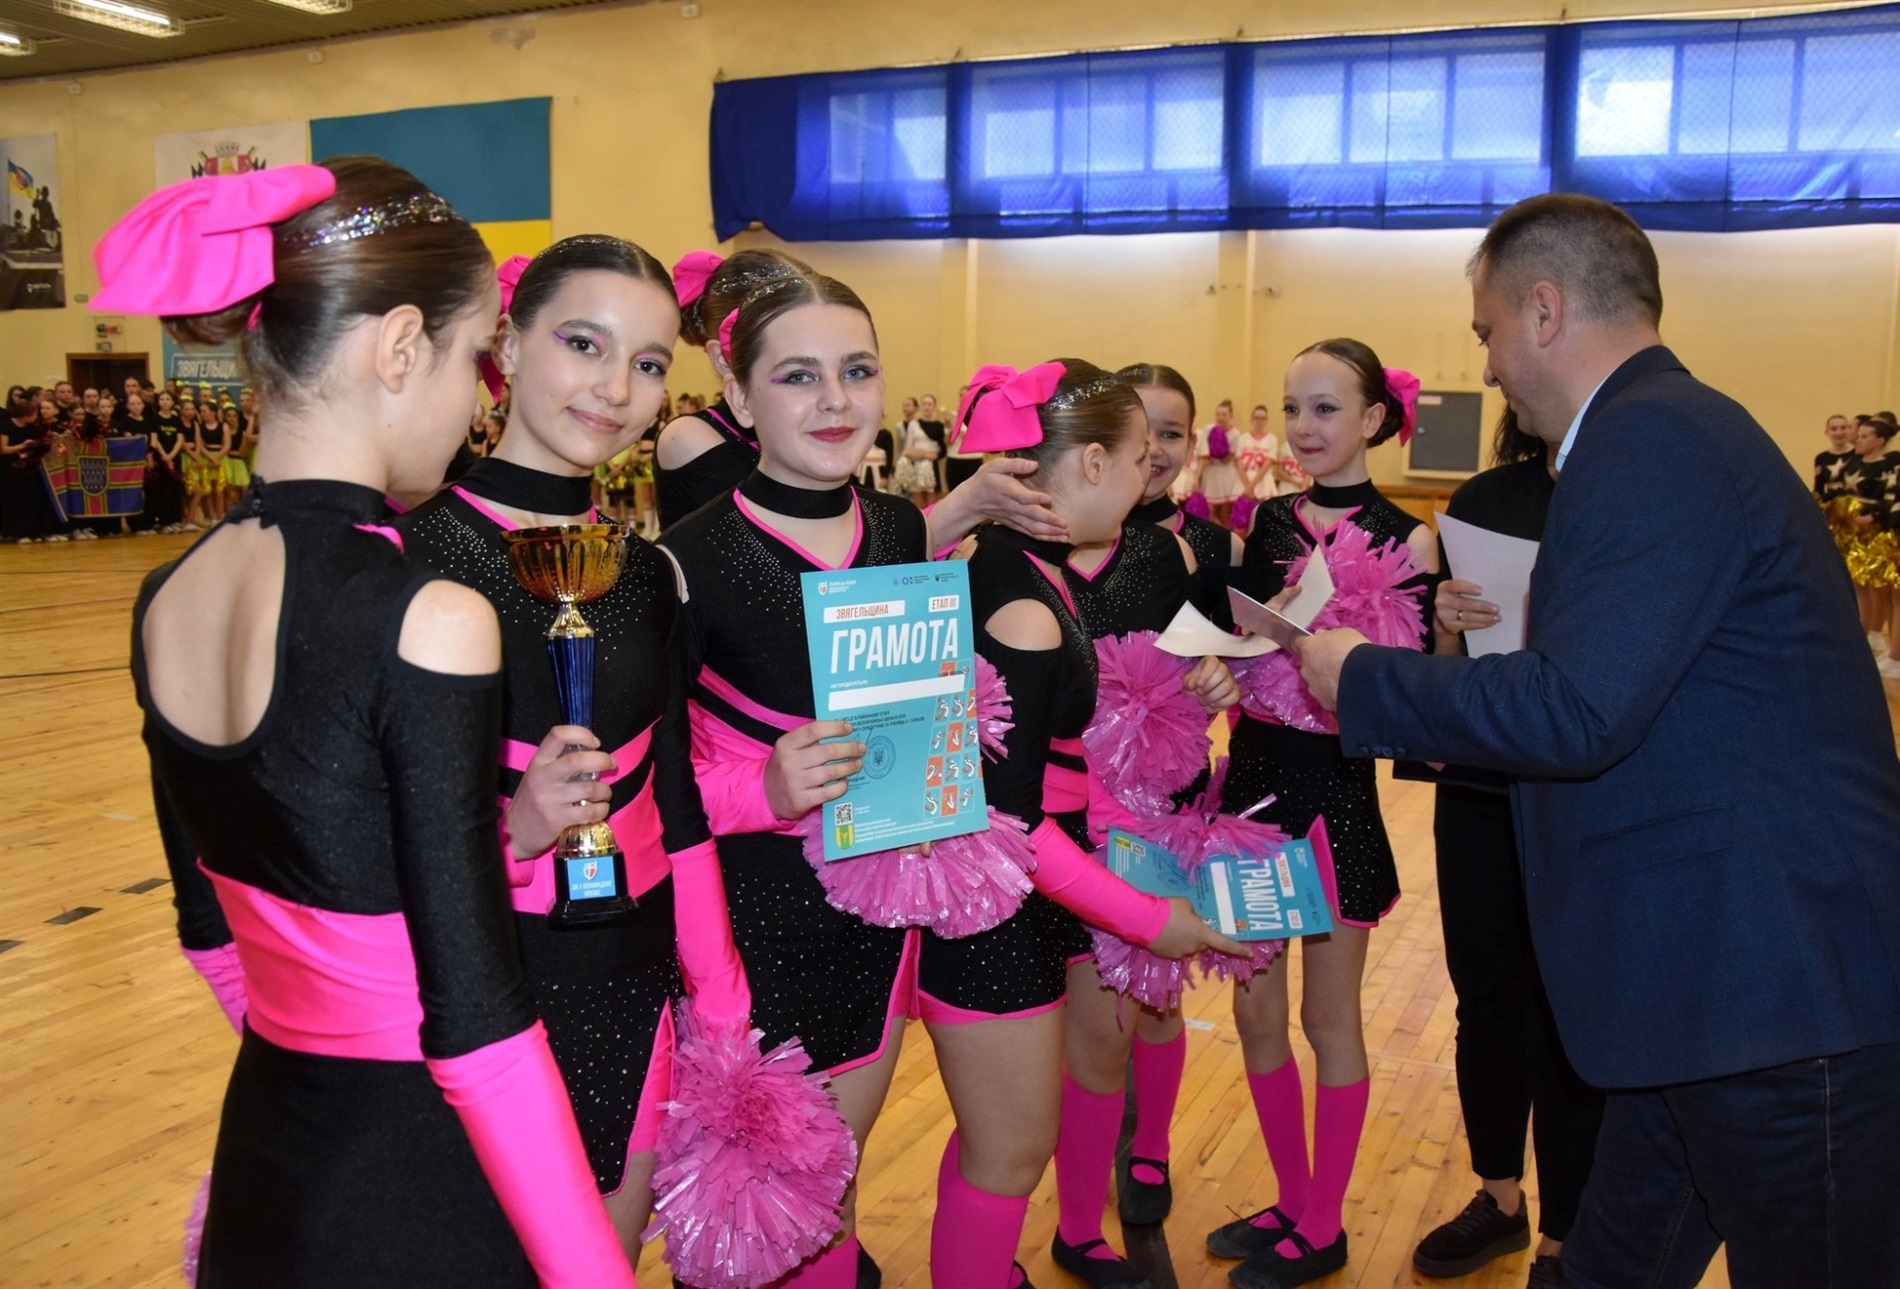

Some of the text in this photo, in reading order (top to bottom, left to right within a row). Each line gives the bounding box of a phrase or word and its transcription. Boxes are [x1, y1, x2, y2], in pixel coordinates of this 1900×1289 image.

[836, 604, 889, 620] ЗВЯГЕЛЬЩИНА
[931, 598, 949, 610] ЕТАП
[830, 618, 958, 674] ГРАМОТА
[1237, 858, 1283, 930] ГРАМОТА
